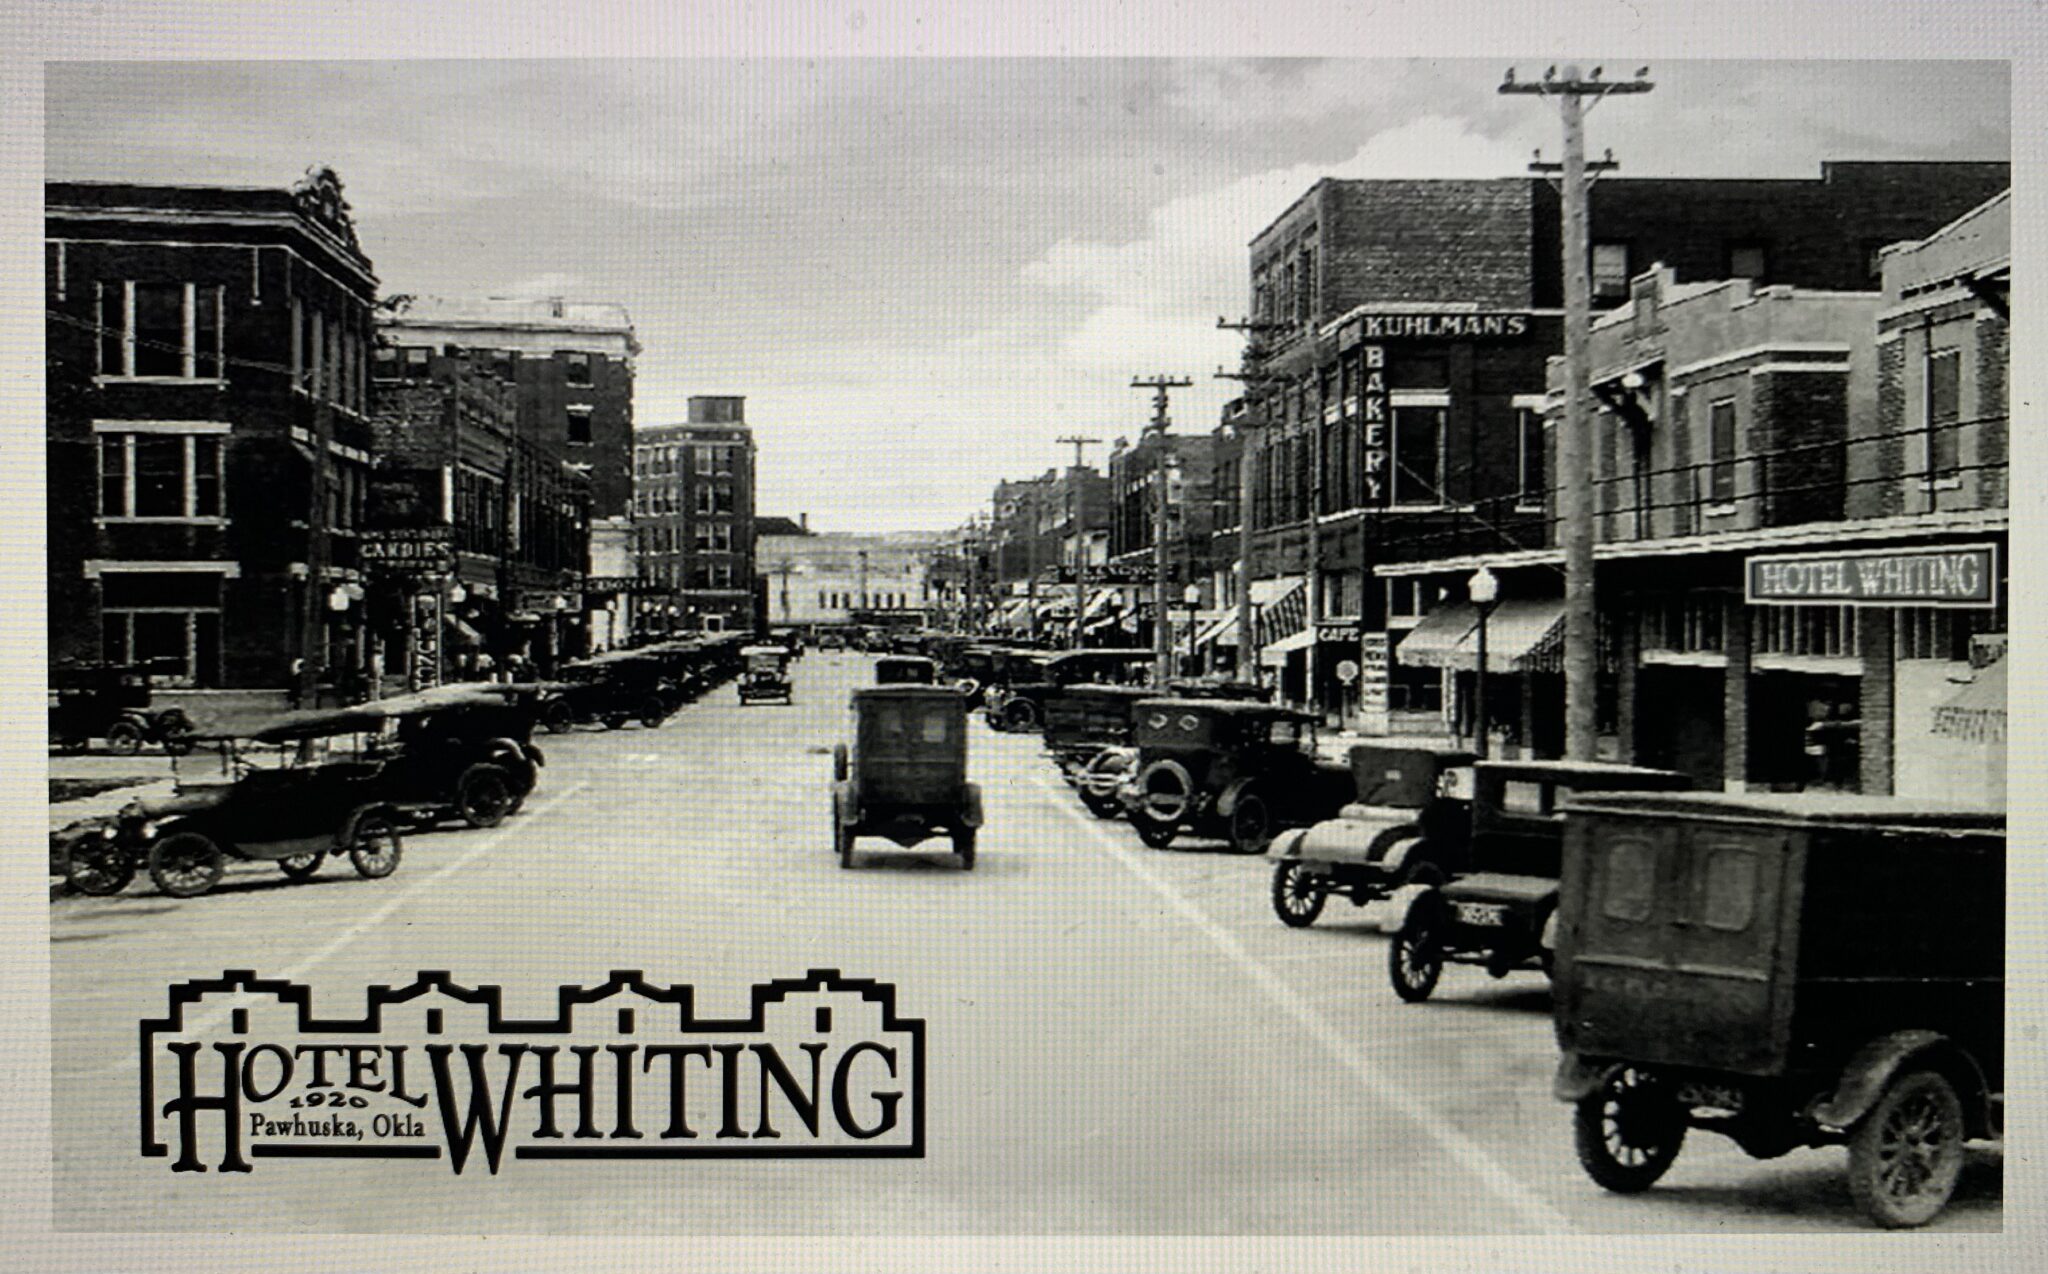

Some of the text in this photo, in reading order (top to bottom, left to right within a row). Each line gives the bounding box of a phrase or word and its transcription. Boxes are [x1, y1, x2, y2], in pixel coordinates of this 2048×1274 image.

[1365, 315, 1527, 337] KUHLMAN'S
[1364, 346, 1387, 499] BAKERY
[1761, 553, 1980, 597] HOTEL WHITING
[1319, 627, 1359, 641] CAFE
